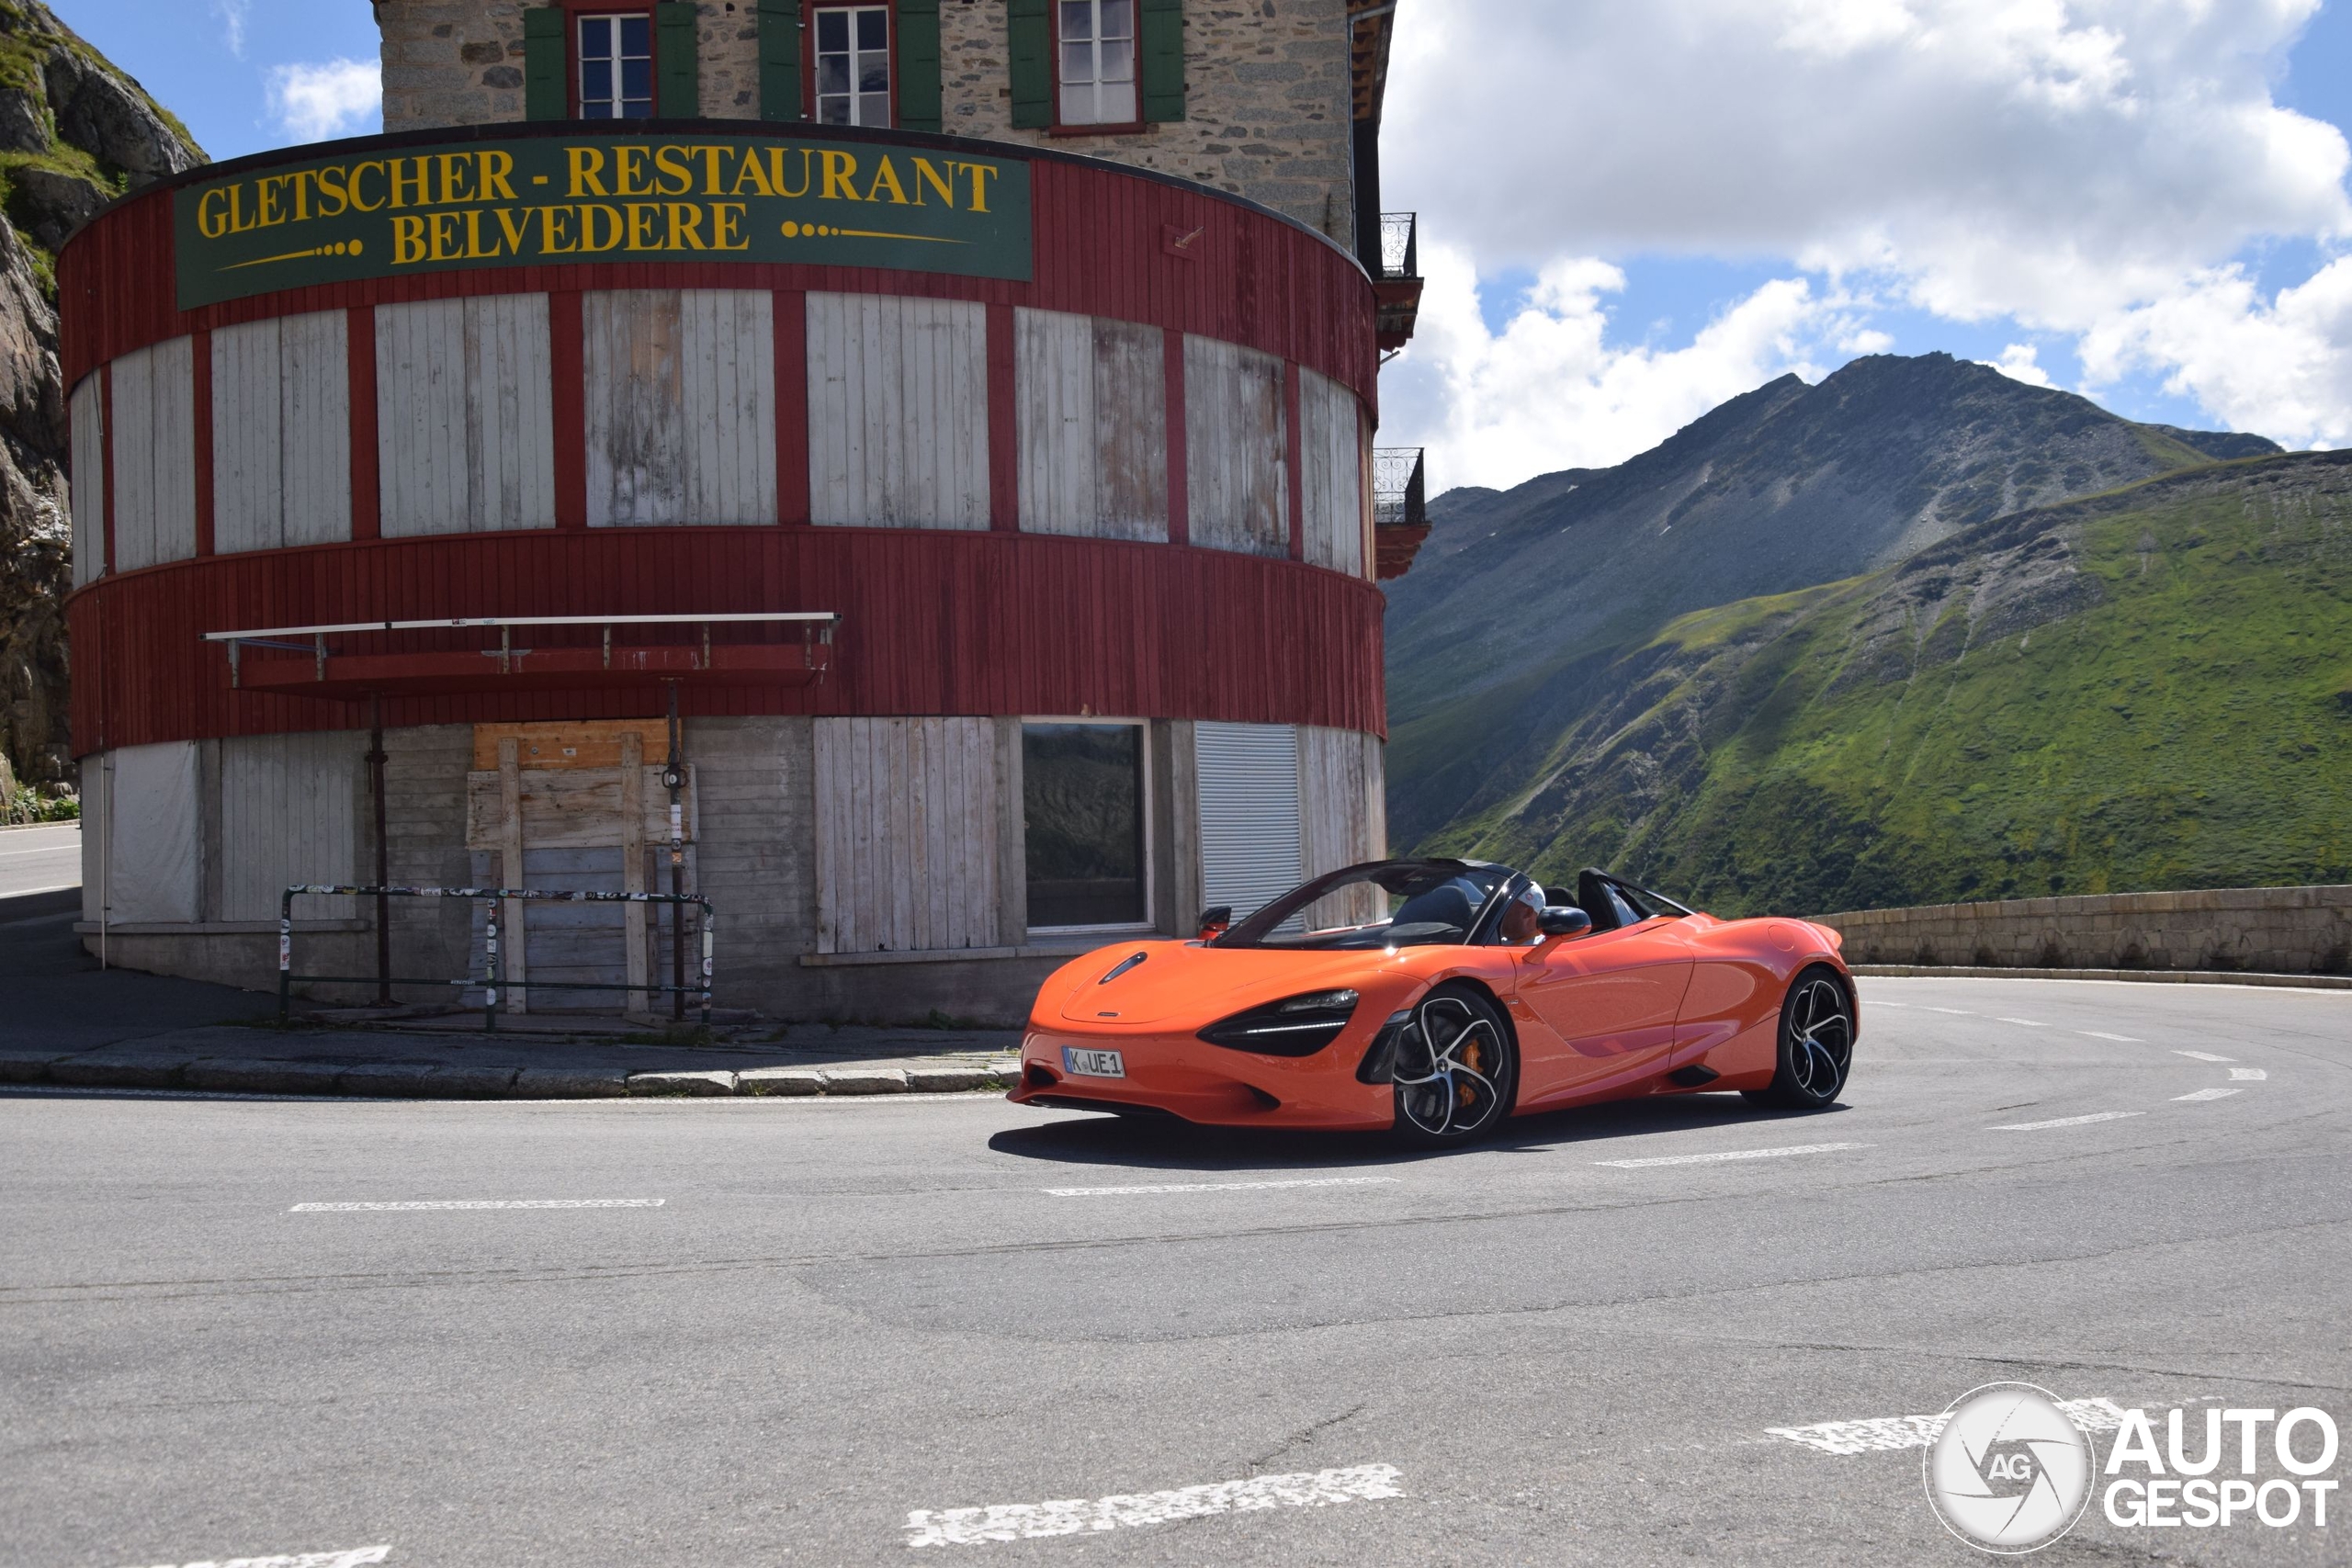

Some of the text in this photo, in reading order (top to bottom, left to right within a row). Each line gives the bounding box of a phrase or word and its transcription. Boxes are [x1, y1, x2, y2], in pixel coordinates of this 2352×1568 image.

[198, 150, 519, 239] GLETSCHER
[564, 144, 998, 213] RESTAURANT
[390, 202, 750, 265] BELVEDERE
